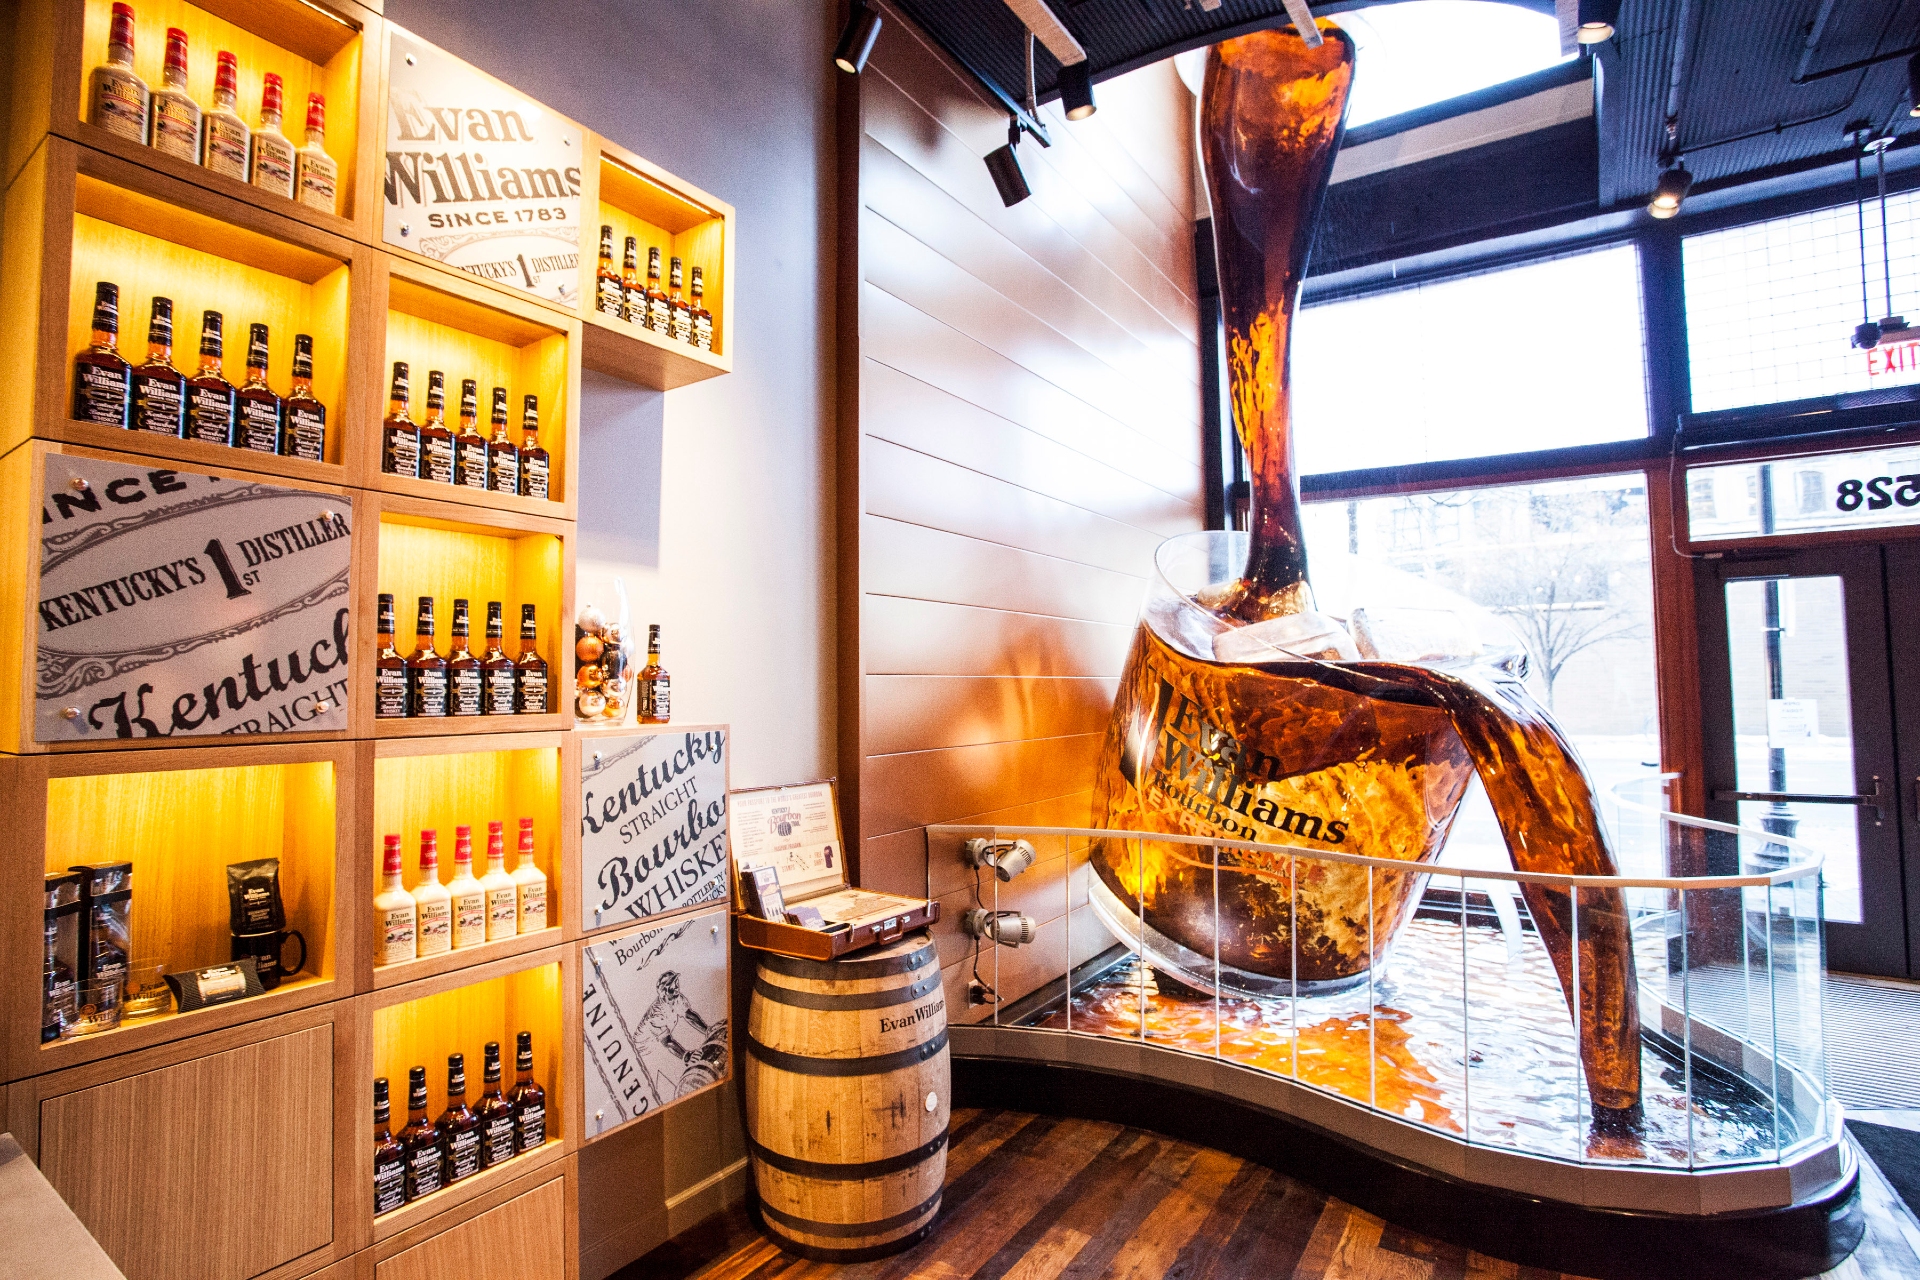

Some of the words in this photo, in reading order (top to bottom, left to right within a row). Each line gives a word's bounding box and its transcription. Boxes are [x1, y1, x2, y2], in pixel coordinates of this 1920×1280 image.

[389, 90, 535, 144] Evan
[385, 151, 581, 206] Williams
[428, 211, 508, 228] SINCE
[514, 207, 567, 222] 1783
[516, 254, 536, 288] 1
[533, 275, 541, 284] ST
[1866, 342, 1920, 376] EXIT
[92, 365, 123, 380] Evan
[82, 373, 130, 390] Williams
[148, 378, 177, 391] Evan
[139, 385, 184, 401] Williams
[200, 388, 227, 401] Evan
[191, 395, 234, 410] Williams
[250, 400, 275, 412] Evan
[242, 406, 281, 421] Williams
[297, 409, 320, 421] Evan
[290, 415, 325, 429] Williams
[42, 469, 187, 524] NCE
[237, 511, 351, 568] DISTILLER
[204, 538, 251, 600] 1
[243, 570, 261, 586] ST
[39, 556, 207, 632] KENTUCKY'S
[376, 675, 408, 684] Williams
[381, 668, 402, 676] Evan
[424, 669, 442, 677] Evan
[460, 669, 478, 677] Evan
[525, 669, 542, 677] Evan
[418, 676, 447, 684] Williams
[454, 676, 482, 684] Williams
[489, 676, 515, 684] Williams
[520, 676, 547, 684] Williams
[1170, 692, 1281, 782] Evan
[1165, 730, 1349, 845] Williams
[619, 775, 699, 845] STRAIGHT
[1154, 769, 1257, 843] Bourbon
[767, 806, 801, 834] Bourbon
[598, 793, 726, 911] Bourbo
[457, 904, 484, 912] Williams
[491, 898, 516, 906] Williams
[385, 918, 415, 927] Williams
[421, 911, 450, 919] Williams
[879, 1016, 916, 1033] Evan
[518, 1109, 546, 1122] Williams
[524, 1104, 541, 1115] Evan
[486, 1121, 514, 1136] Williams
[491, 1117, 509, 1128] Evan
[450, 1134, 479, 1150] Williams
[456, 1131, 474, 1142] Evan
[411, 1150, 441, 1167] Williams
[416, 1146, 436, 1159] Evan
[373, 1164, 405, 1182] Williams
[380, 1161, 400, 1173] Evan
